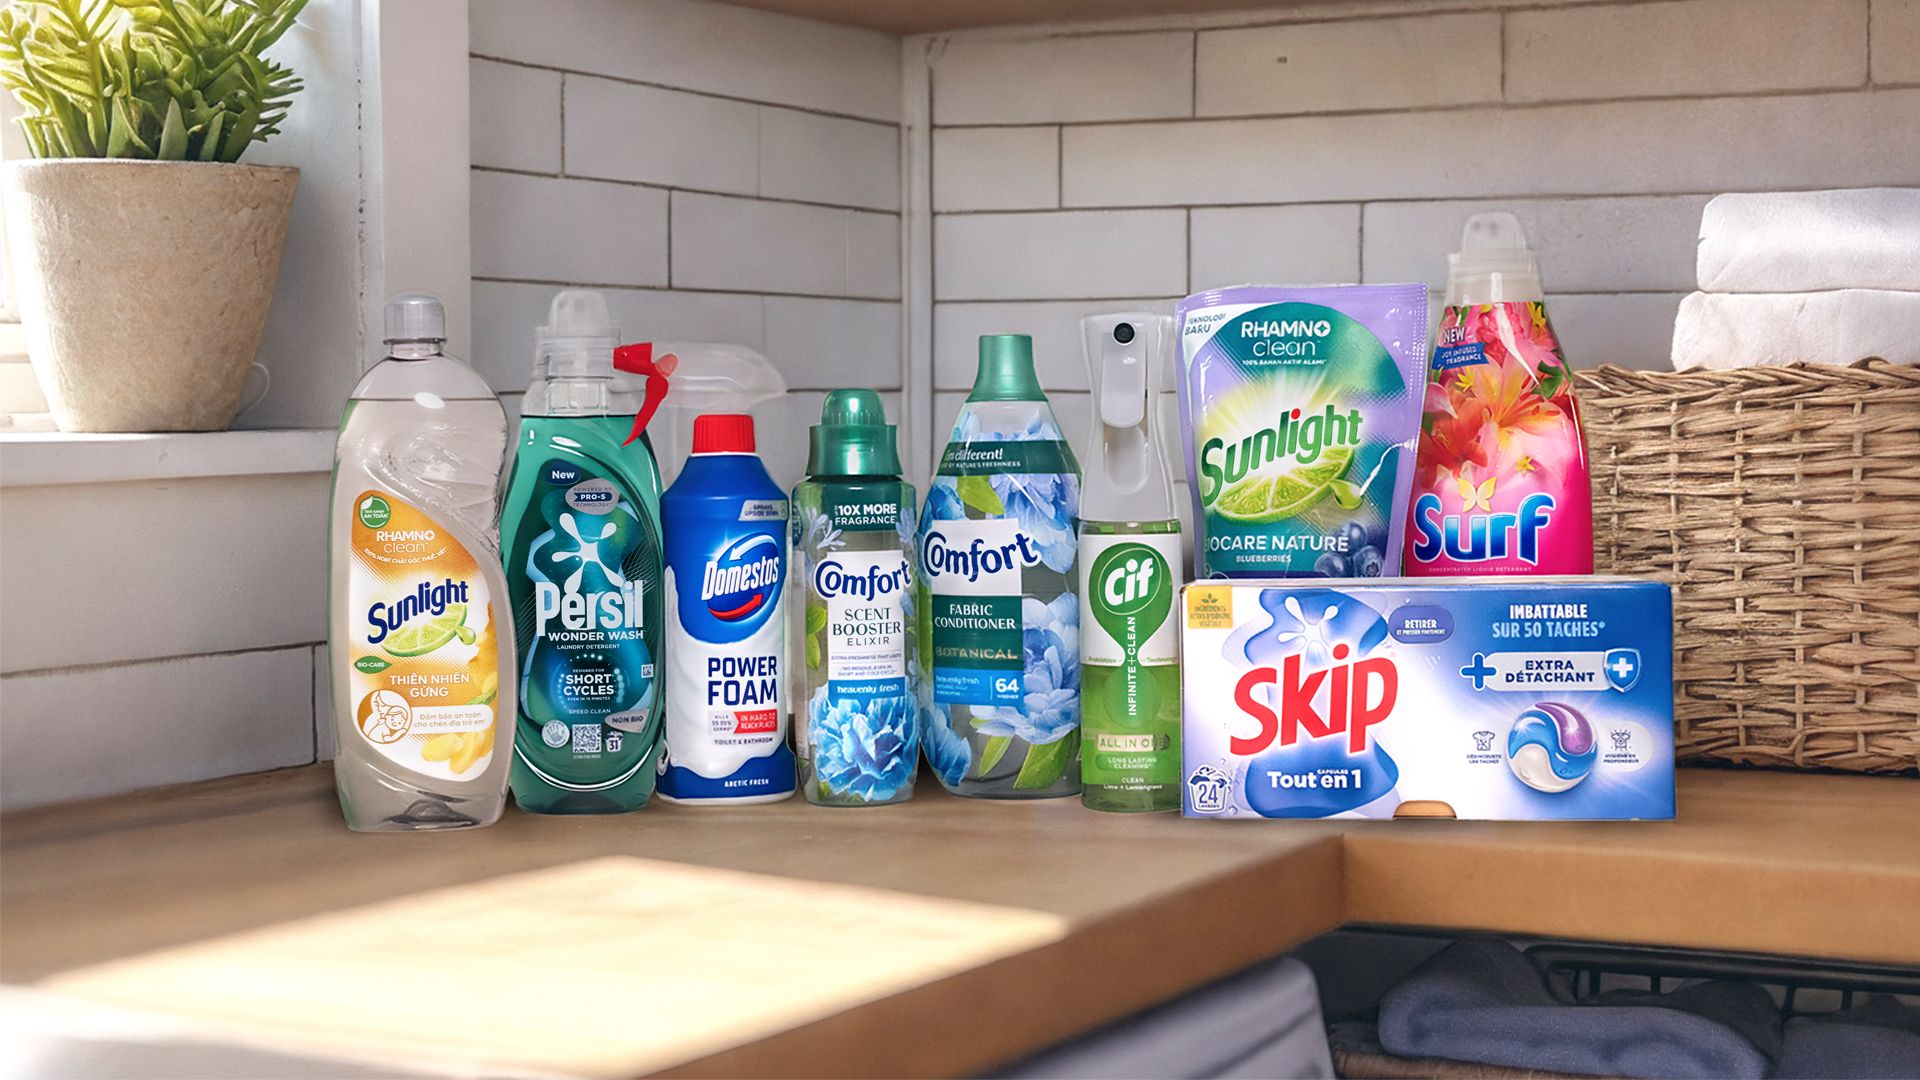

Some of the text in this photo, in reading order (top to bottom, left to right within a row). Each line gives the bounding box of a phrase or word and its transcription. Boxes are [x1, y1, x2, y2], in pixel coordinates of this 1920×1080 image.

[1185, 323, 1211, 336] BARU
[1241, 320, 1331, 338] RHAMNO
[1444, 327, 1466, 344] NEW
[1253, 340, 1316, 357] clean
[1201, 404, 1363, 508] Sunlight
[551, 471, 575, 479] New
[839, 504, 861, 516] 10X
[863, 503, 897, 515] MORE
[835, 516, 896, 526] FRAGRANCE
[376, 530, 435, 542] RHAMNO
[1414, 492, 1556, 566] Surf
[384, 542, 425, 554] clean
[1271, 536, 1349, 552] NATURE
[924, 531, 1038, 583] Comfort
[1236, 555, 1292, 564] BLUEBERRIES
[702, 555, 780, 601] Domestos
[815, 560, 911, 602] Comfort
[1105, 557, 1154, 606] Cif
[367, 578, 469, 644] Sunlight
[535, 579, 643, 636] Persil
[949, 603, 993, 616] FABRIC
[1509, 604, 1588, 619] IMBATTABLE
[844, 608, 892, 622] SCENT
[832, 621, 902, 636] BOOSTER
[934, 616, 1017, 629] CONDITIONER
[1404, 619, 1437, 629] RETIRER
[547, 630, 644, 642] WONDER WASH
[1492, 623, 1519, 638] SUR
[1524, 622, 1542, 638] 50
[847, 637, 890, 647] ELIXIR
[935, 647, 1018, 659] BOTANICAL
[708, 656, 777, 678] POWER
[1525, 660, 1574, 670] EXTRA
[390, 672, 470, 685] THIÊN NHIÊN
[566, 674, 612, 685] SHORT
[1505, 669, 1595, 683] DÉTACHANT
[563, 685, 615, 696] CYCLES
[708, 678, 777, 706] FOAM
[837, 683, 900, 694] heavenly fresh
[995, 678, 1020, 693] 64
[1230, 643, 1399, 756] Skip
[609, 740, 619, 750] 31
[1100, 739, 1121, 748] ALL
[1125, 739, 1137, 748] IN
[1267, 769, 1362, 789] Tout en 1
[1199, 784, 1218, 804] 24
